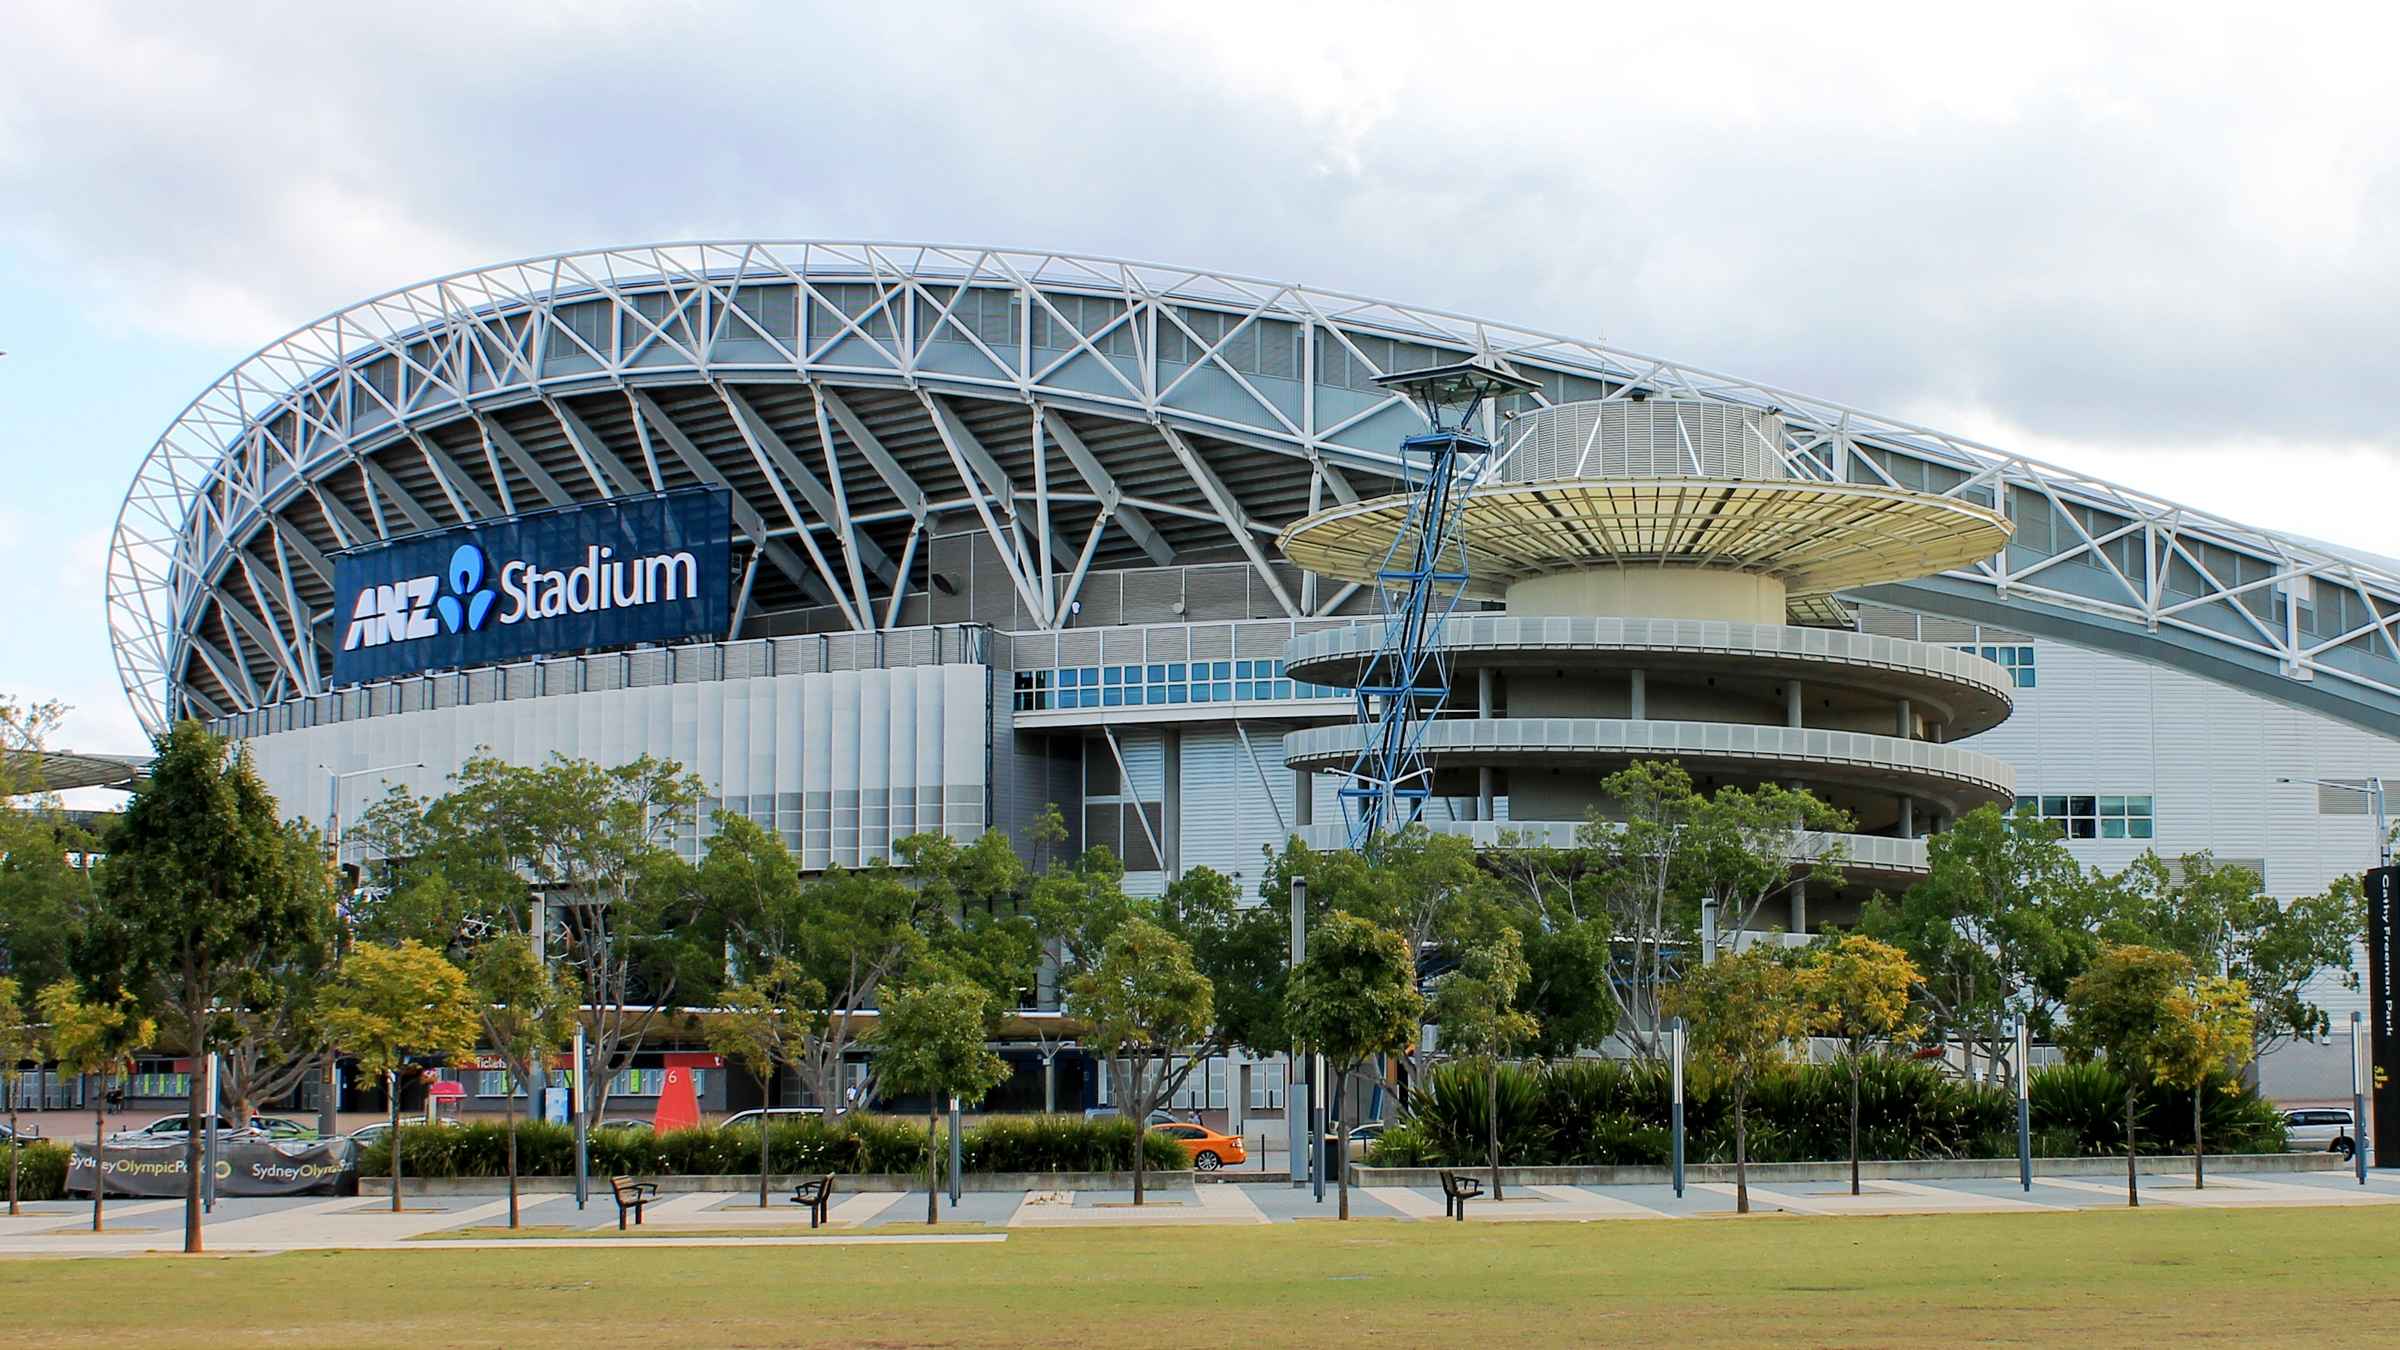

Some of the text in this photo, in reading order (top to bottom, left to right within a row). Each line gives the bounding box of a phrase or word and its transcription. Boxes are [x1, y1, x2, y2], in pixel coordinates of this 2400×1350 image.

[344, 544, 698, 651] ANZ Stadium
[2382, 874, 2390, 924] Cathy
[2385, 1000, 2394, 1037] Park
[667, 1069, 679, 1084] 6
